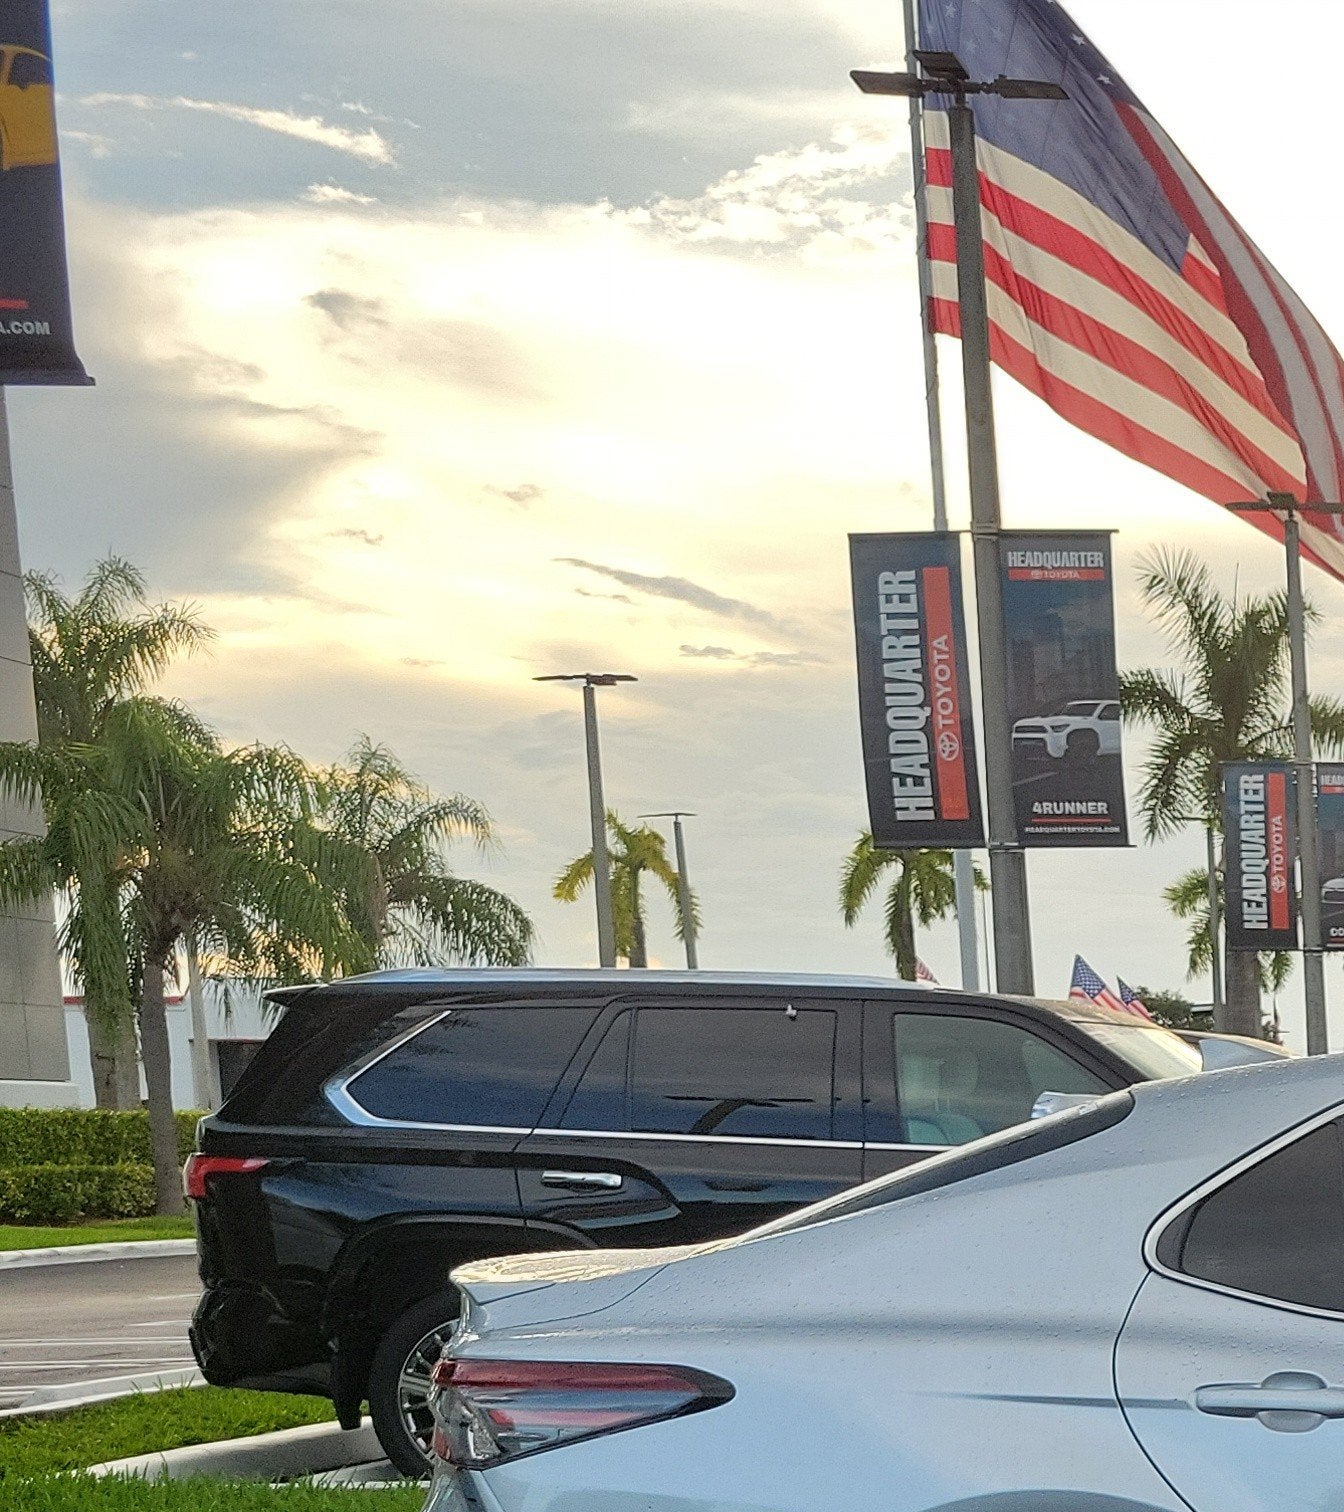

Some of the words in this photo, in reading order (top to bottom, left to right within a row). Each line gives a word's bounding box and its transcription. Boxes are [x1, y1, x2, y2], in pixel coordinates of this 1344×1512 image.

[1008, 551, 1104, 569] HEADQUARTER
[878, 569, 935, 821] HEADQUARTER
[932, 634, 955, 729] TOYOTA
[1032, 801, 1109, 814] 4RUNNER
[1270, 815, 1283, 873] TOYOTA
[1238, 774, 1269, 930] HEADQUARTER
